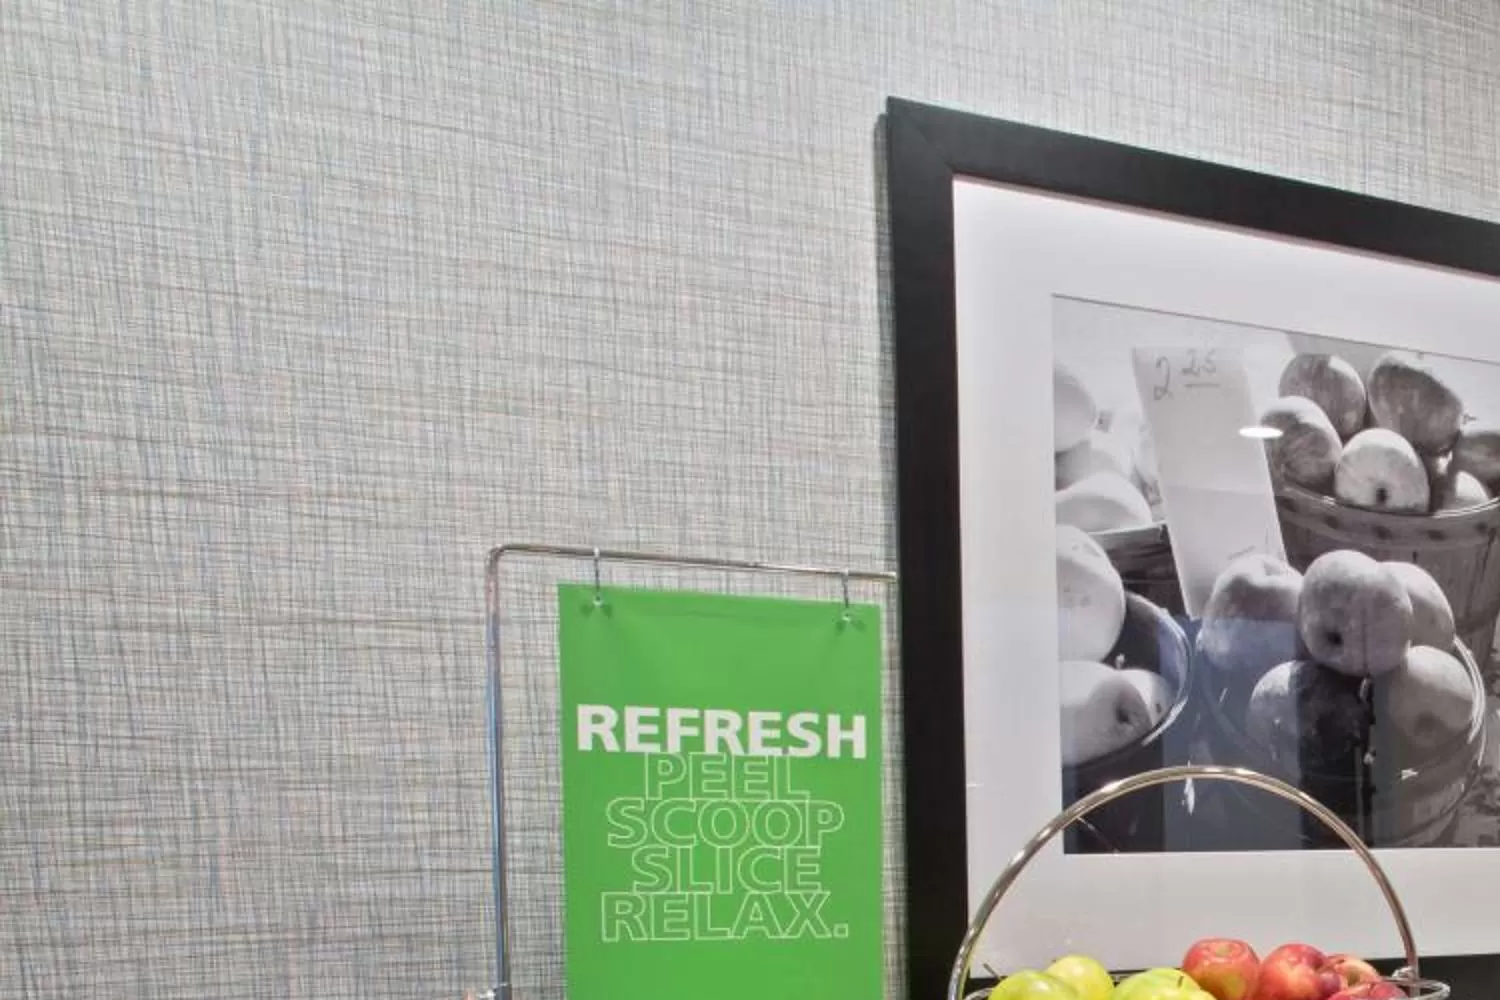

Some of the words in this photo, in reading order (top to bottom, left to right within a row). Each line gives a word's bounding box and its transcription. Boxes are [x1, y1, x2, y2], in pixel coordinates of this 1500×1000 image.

[577, 703, 866, 759] REFRESH
[645, 753, 810, 801] PEEL
[606, 798, 844, 847] SCOOP
[631, 846, 821, 894] SLICE
[601, 891, 848, 941] RELAX.
